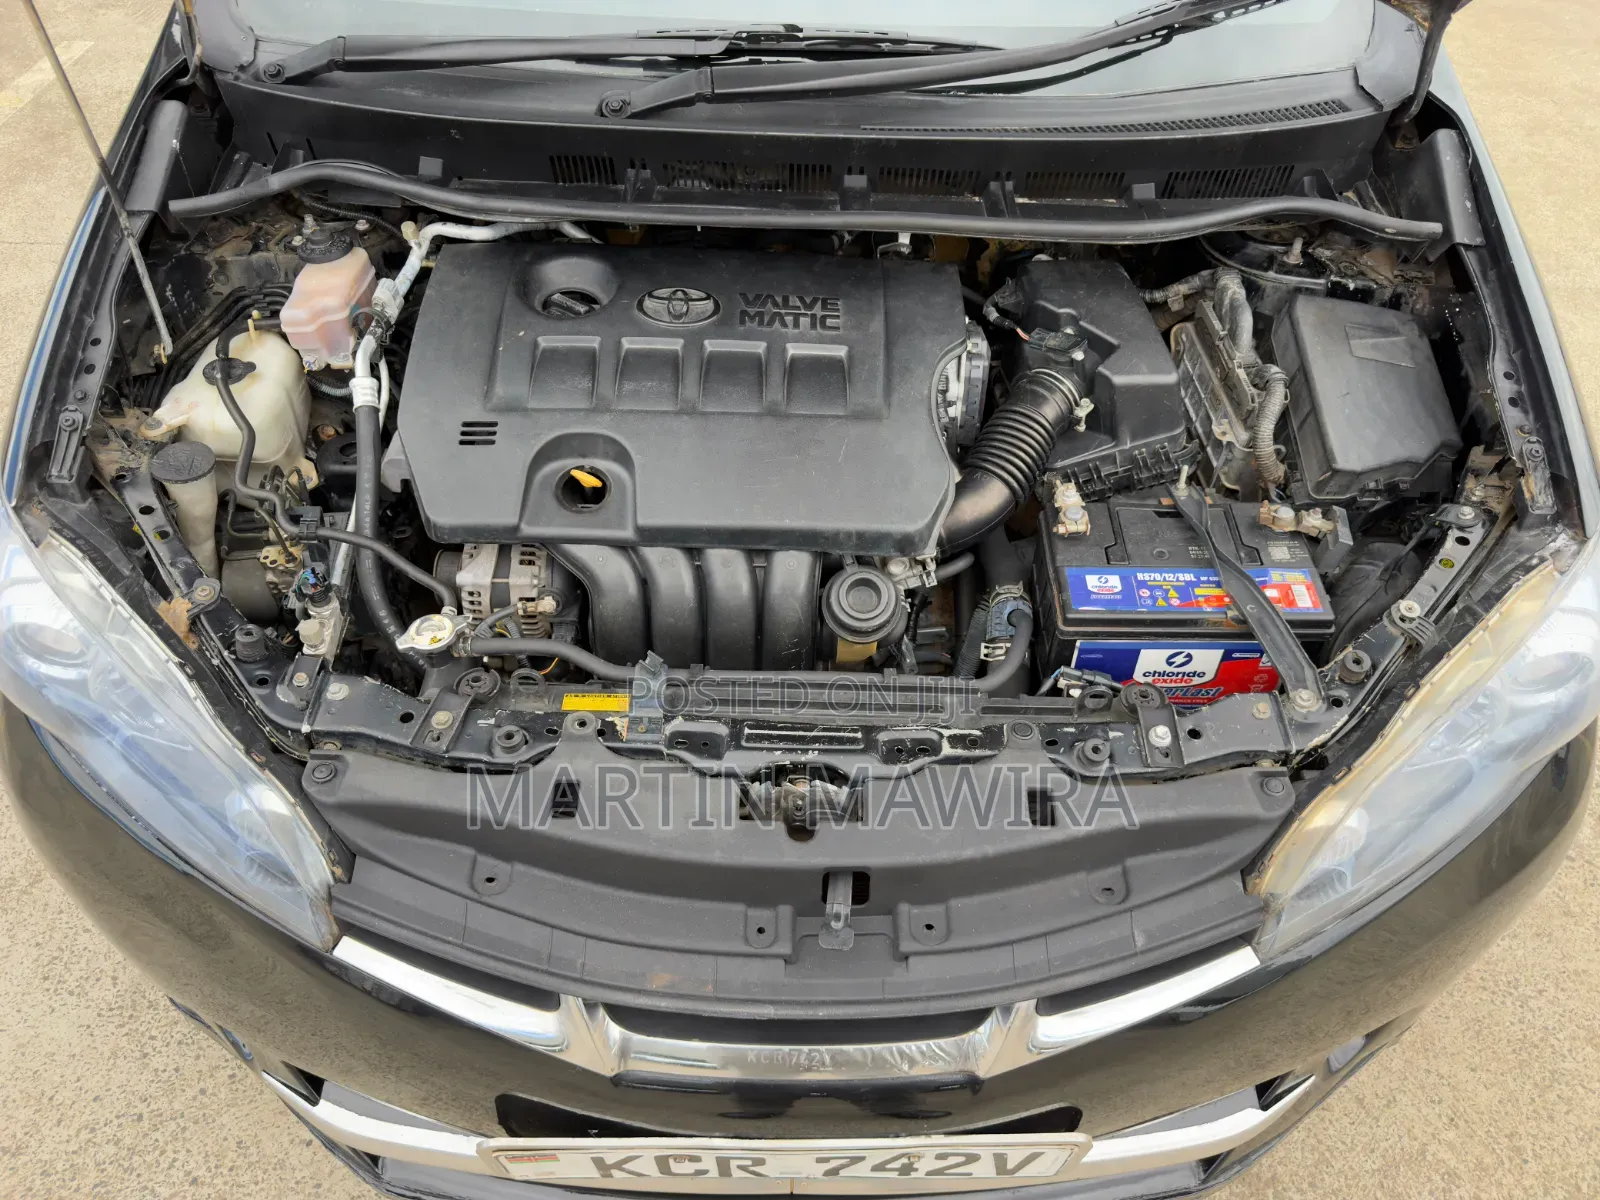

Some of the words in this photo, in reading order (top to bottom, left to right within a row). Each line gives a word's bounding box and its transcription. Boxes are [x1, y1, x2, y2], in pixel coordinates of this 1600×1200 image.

[738, 293, 841, 312] VALVE
[738, 310, 841, 332] MATIC
[1142, 670, 1206, 678] chloride
[1151, 677, 1194, 685] exide
[589, 1152, 768, 1178] KCR
[814, 1152, 1046, 1178] 742V
